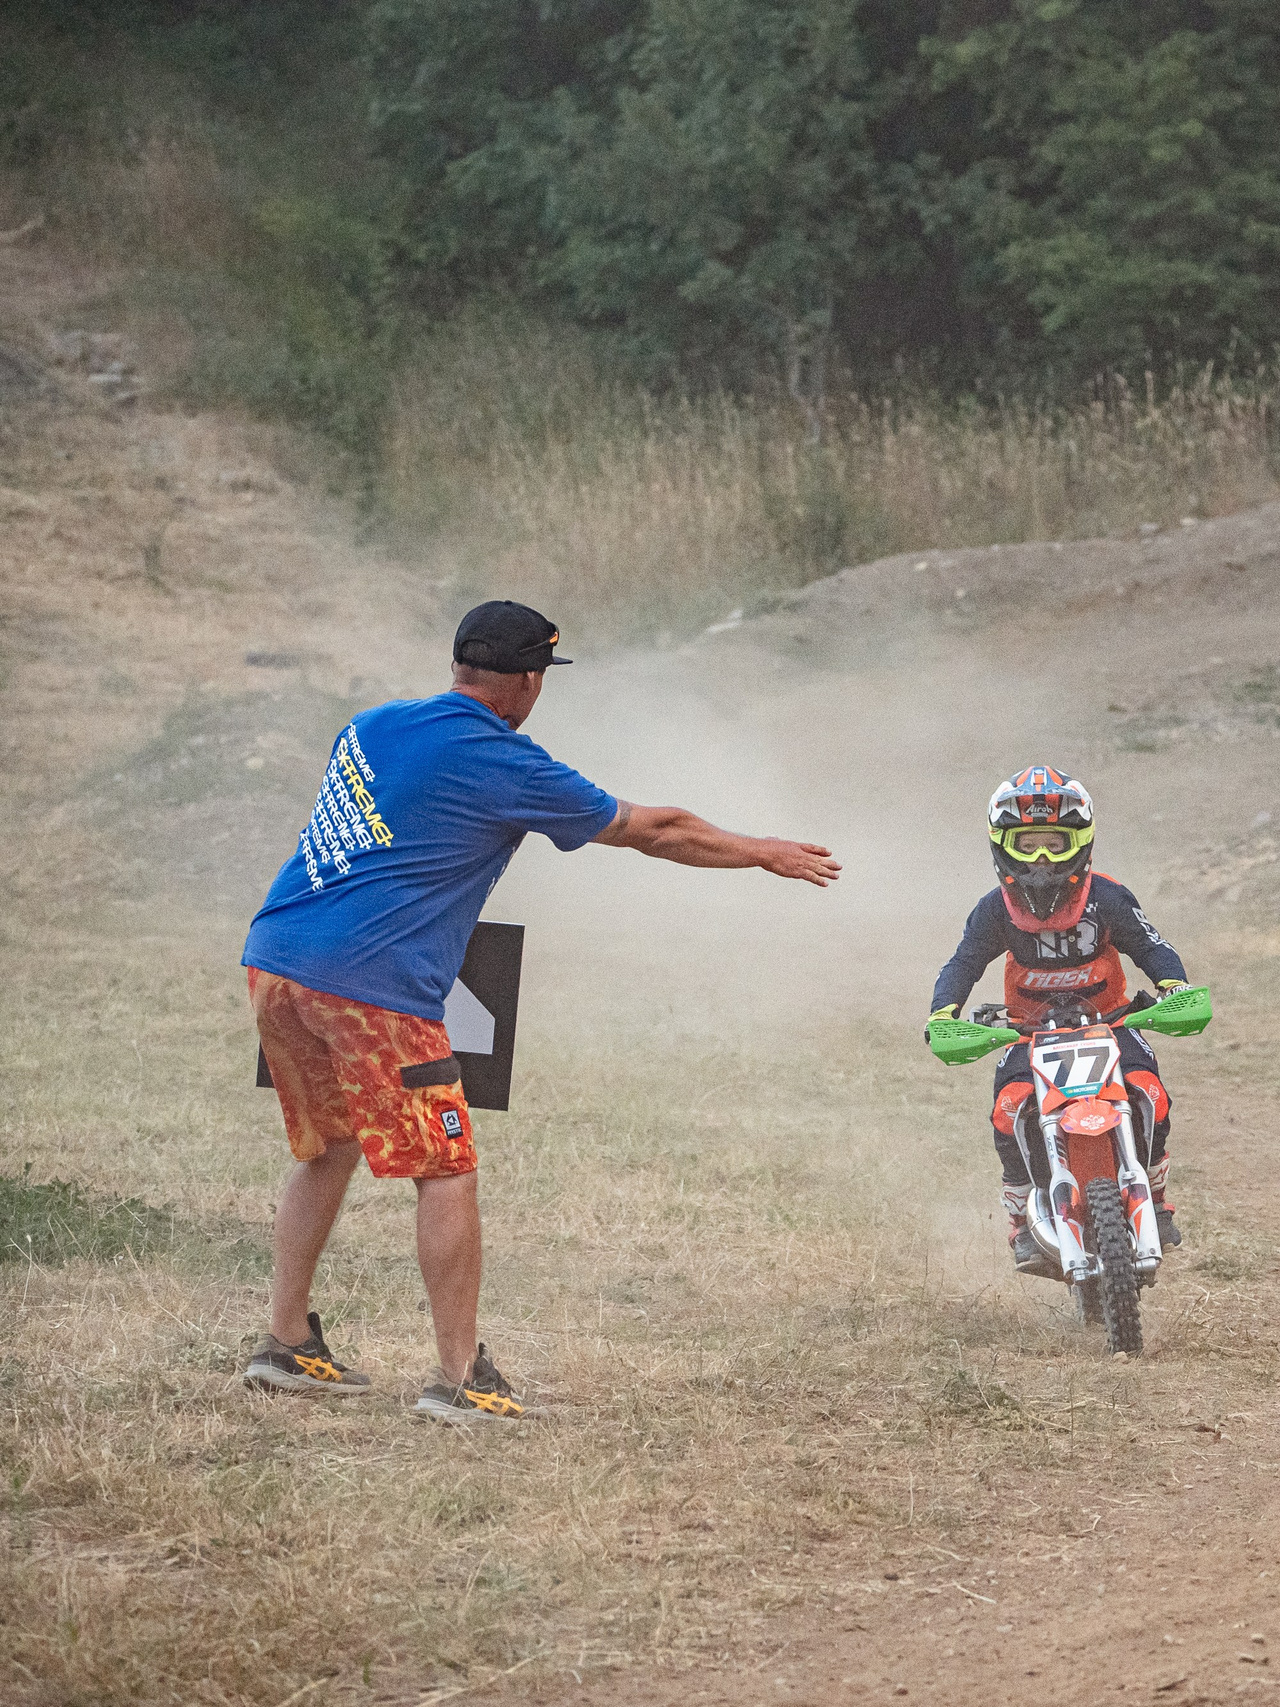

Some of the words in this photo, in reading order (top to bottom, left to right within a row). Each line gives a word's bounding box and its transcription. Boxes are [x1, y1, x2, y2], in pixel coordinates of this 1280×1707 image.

[326, 759, 373, 850] EXTREME
[336, 737, 394, 847] EXTREME
[1025, 804, 1053, 813] Airoh
[1042, 1046, 1110, 1088] 77
